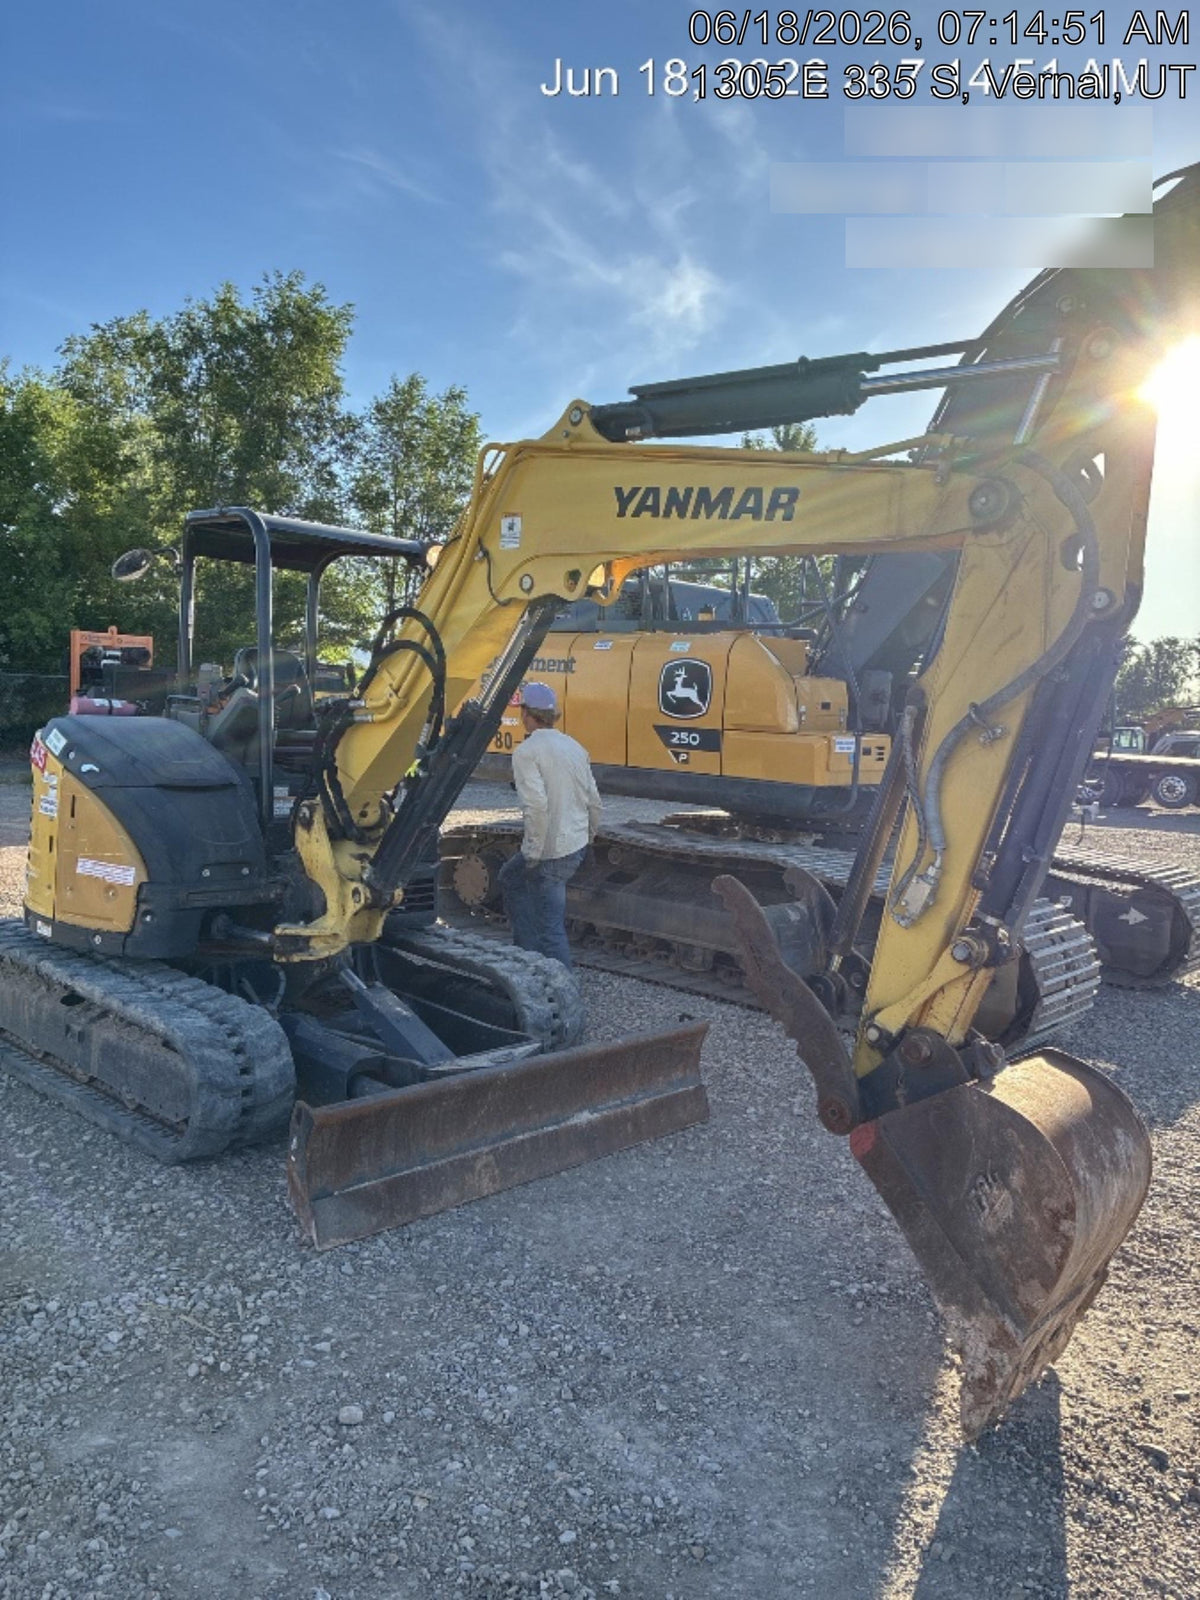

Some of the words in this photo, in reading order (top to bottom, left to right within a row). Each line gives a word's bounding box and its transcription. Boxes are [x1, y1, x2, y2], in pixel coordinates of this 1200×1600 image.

[613, 486, 801, 522] YANMAR
[670, 731, 700, 746] 250
[678, 752, 688, 763] P
